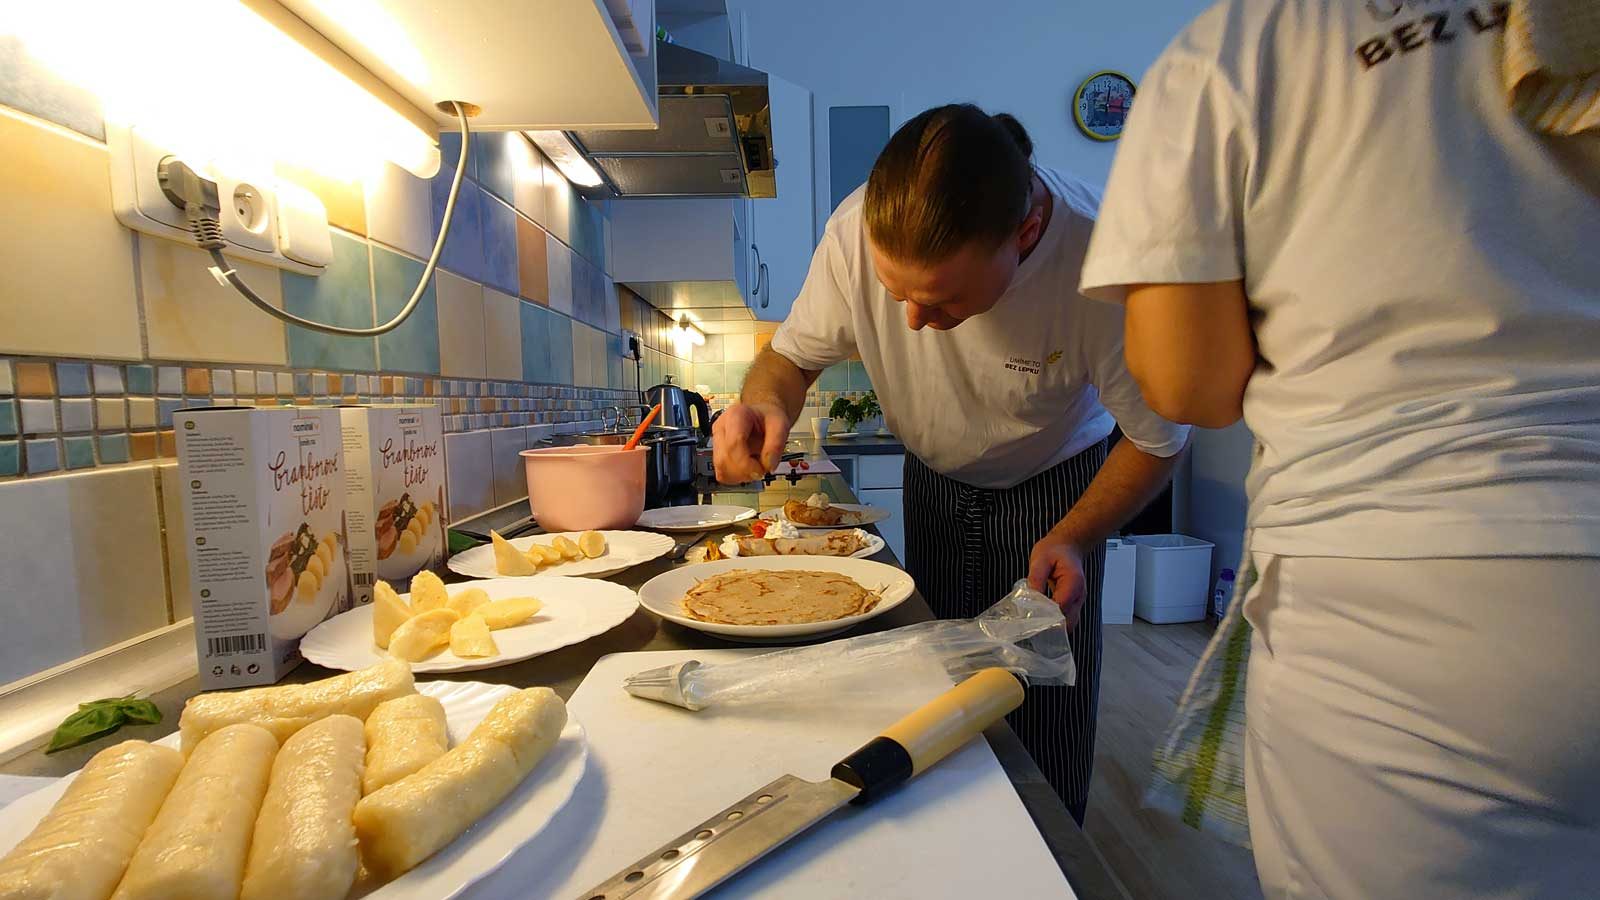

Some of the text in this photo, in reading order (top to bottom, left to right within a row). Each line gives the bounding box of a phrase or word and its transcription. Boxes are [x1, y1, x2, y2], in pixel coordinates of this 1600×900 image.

[1354, 11, 1457, 70] BEZ
[1103, 80, 1111, 88] 12
[1018, 366, 1039, 374] LEPKU
